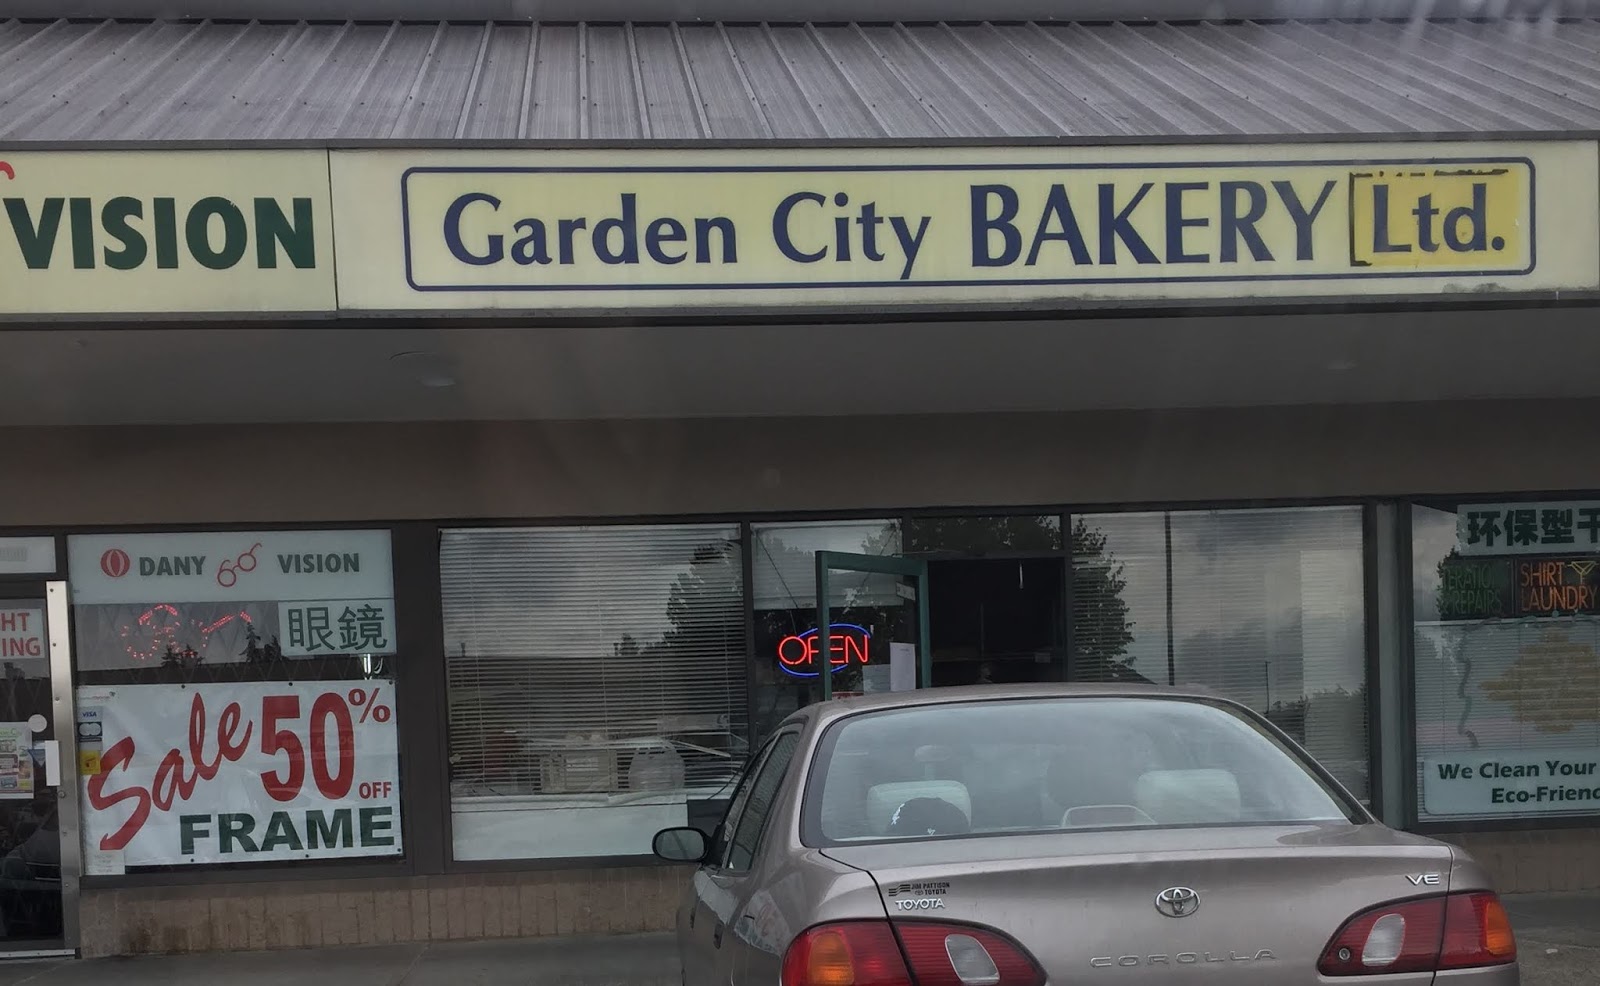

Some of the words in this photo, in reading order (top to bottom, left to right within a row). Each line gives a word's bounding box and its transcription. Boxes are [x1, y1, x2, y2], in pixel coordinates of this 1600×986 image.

[3, 196, 316, 270] VISION
[443, 192, 738, 265] Garden
[772, 191, 931, 280] City
[970, 180, 1338, 267] BAKERY
[1373, 182, 1506, 253] Ltd.
[139, 555, 206, 576] DANY
[277, 552, 360, 574] VISION
[1520, 561, 1565, 586] SHIRT
[1521, 585, 1598, 612] LAUNDRY
[287, 604, 387, 652] 眼鏡
[778, 634, 869, 665] OPEN
[88, 692, 253, 851] Sale
[1438, 763, 1473, 780] We
[1479, 762, 1540, 779] Clean
[1546, 760, 1597, 777] Your
[359, 782, 392, 799] OFF
[179, 806, 395, 855] FRAME
[1405, 873, 1440, 886] VE
[895, 898, 945, 911] TOYOTA
[1089, 948, 1279, 970] COROLLA
